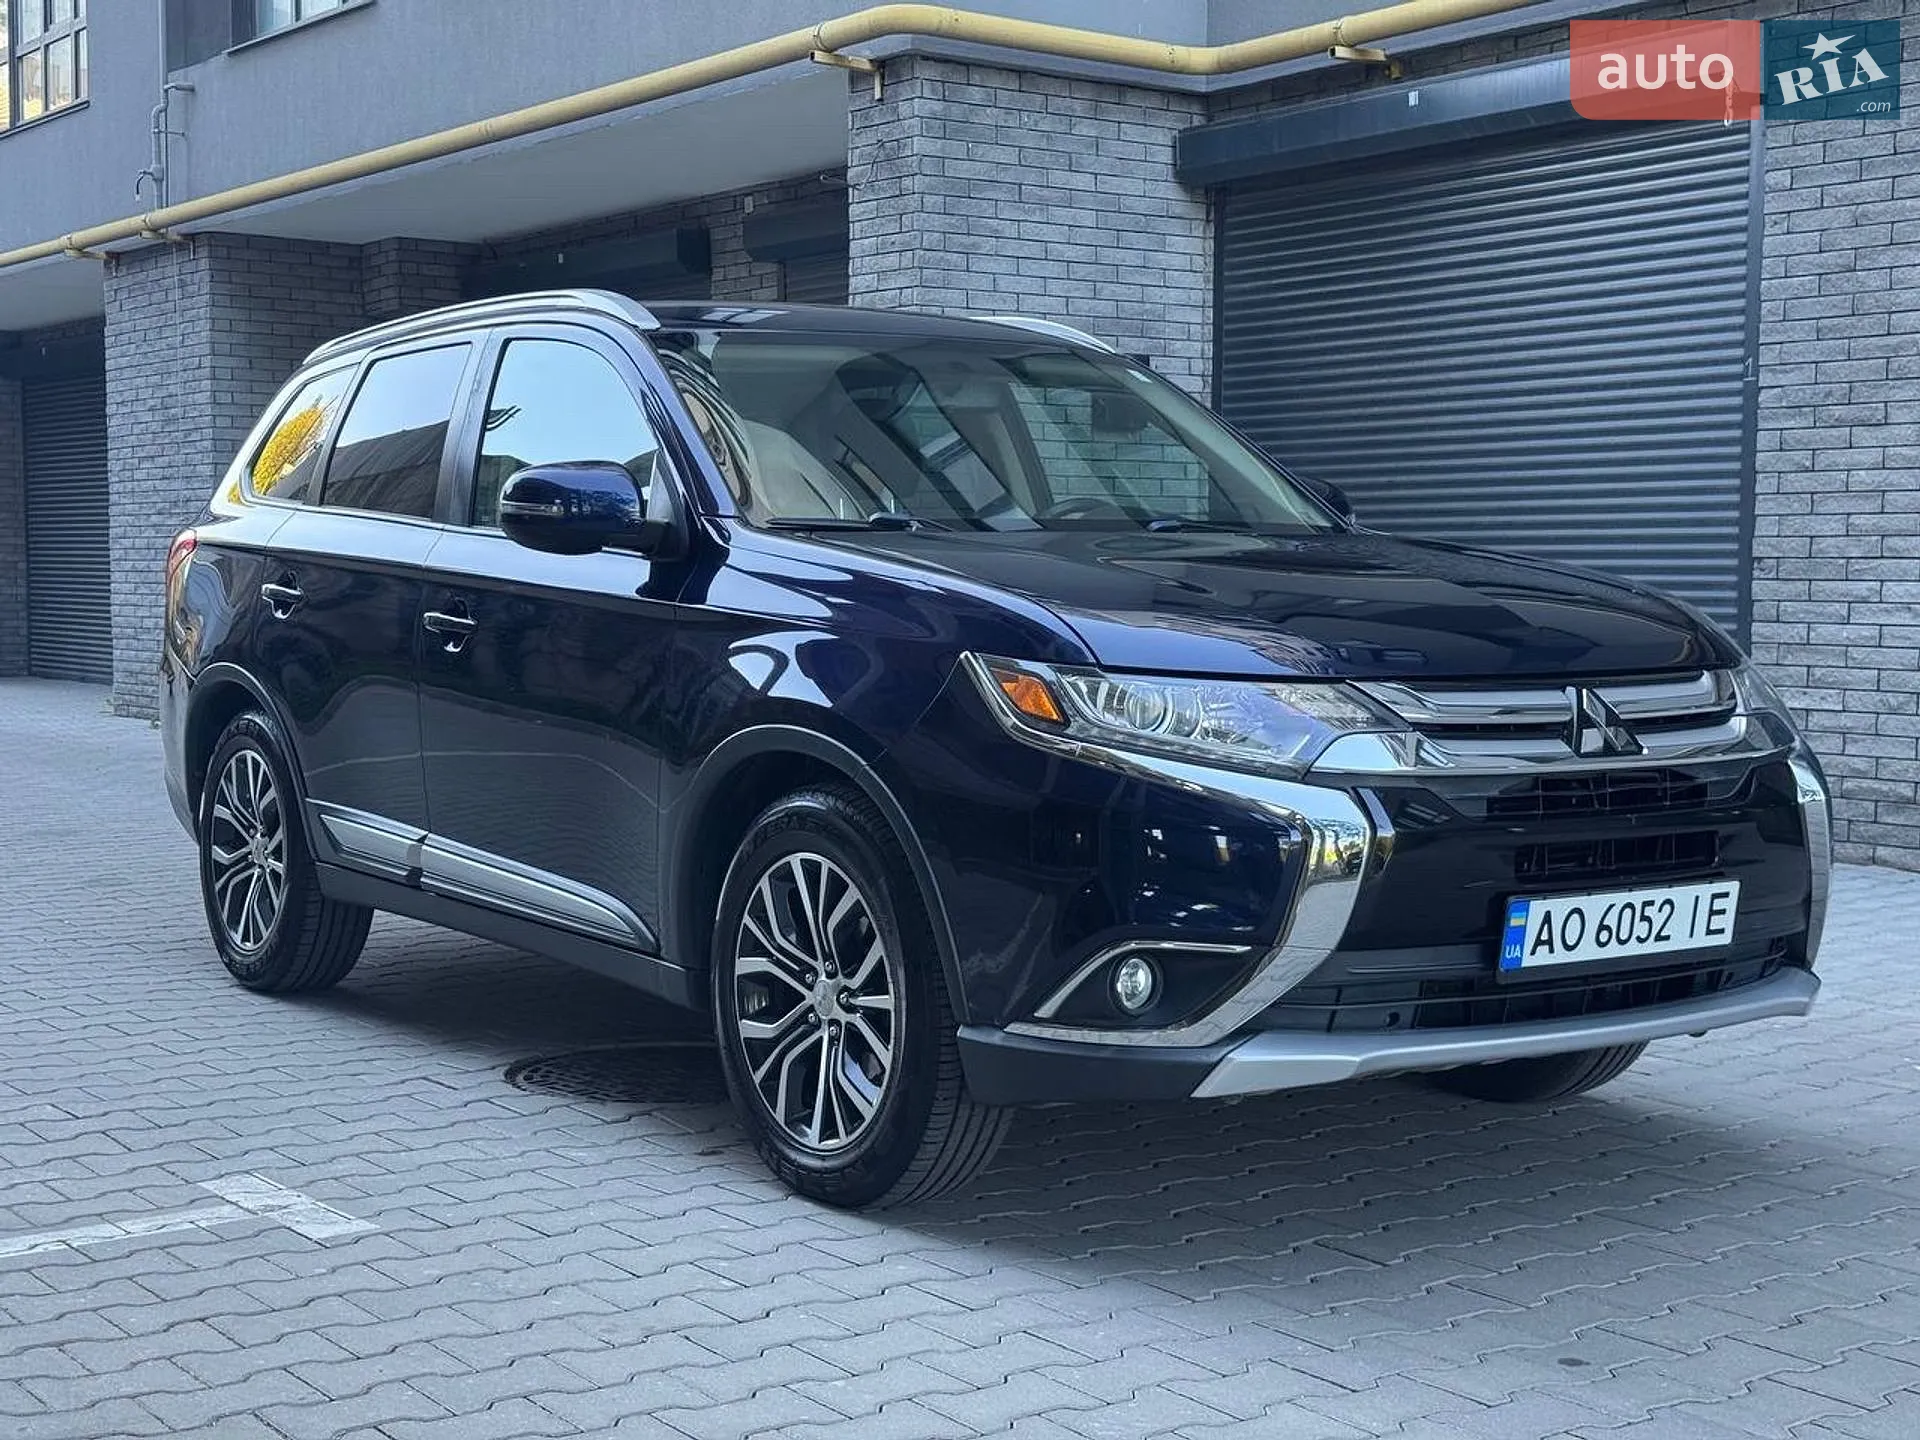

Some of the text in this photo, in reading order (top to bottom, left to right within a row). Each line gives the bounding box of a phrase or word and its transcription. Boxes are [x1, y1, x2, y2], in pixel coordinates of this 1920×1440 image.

[1530, 891, 1731, 956] AO 6052 IE
[1505, 944, 1522, 959] UA
